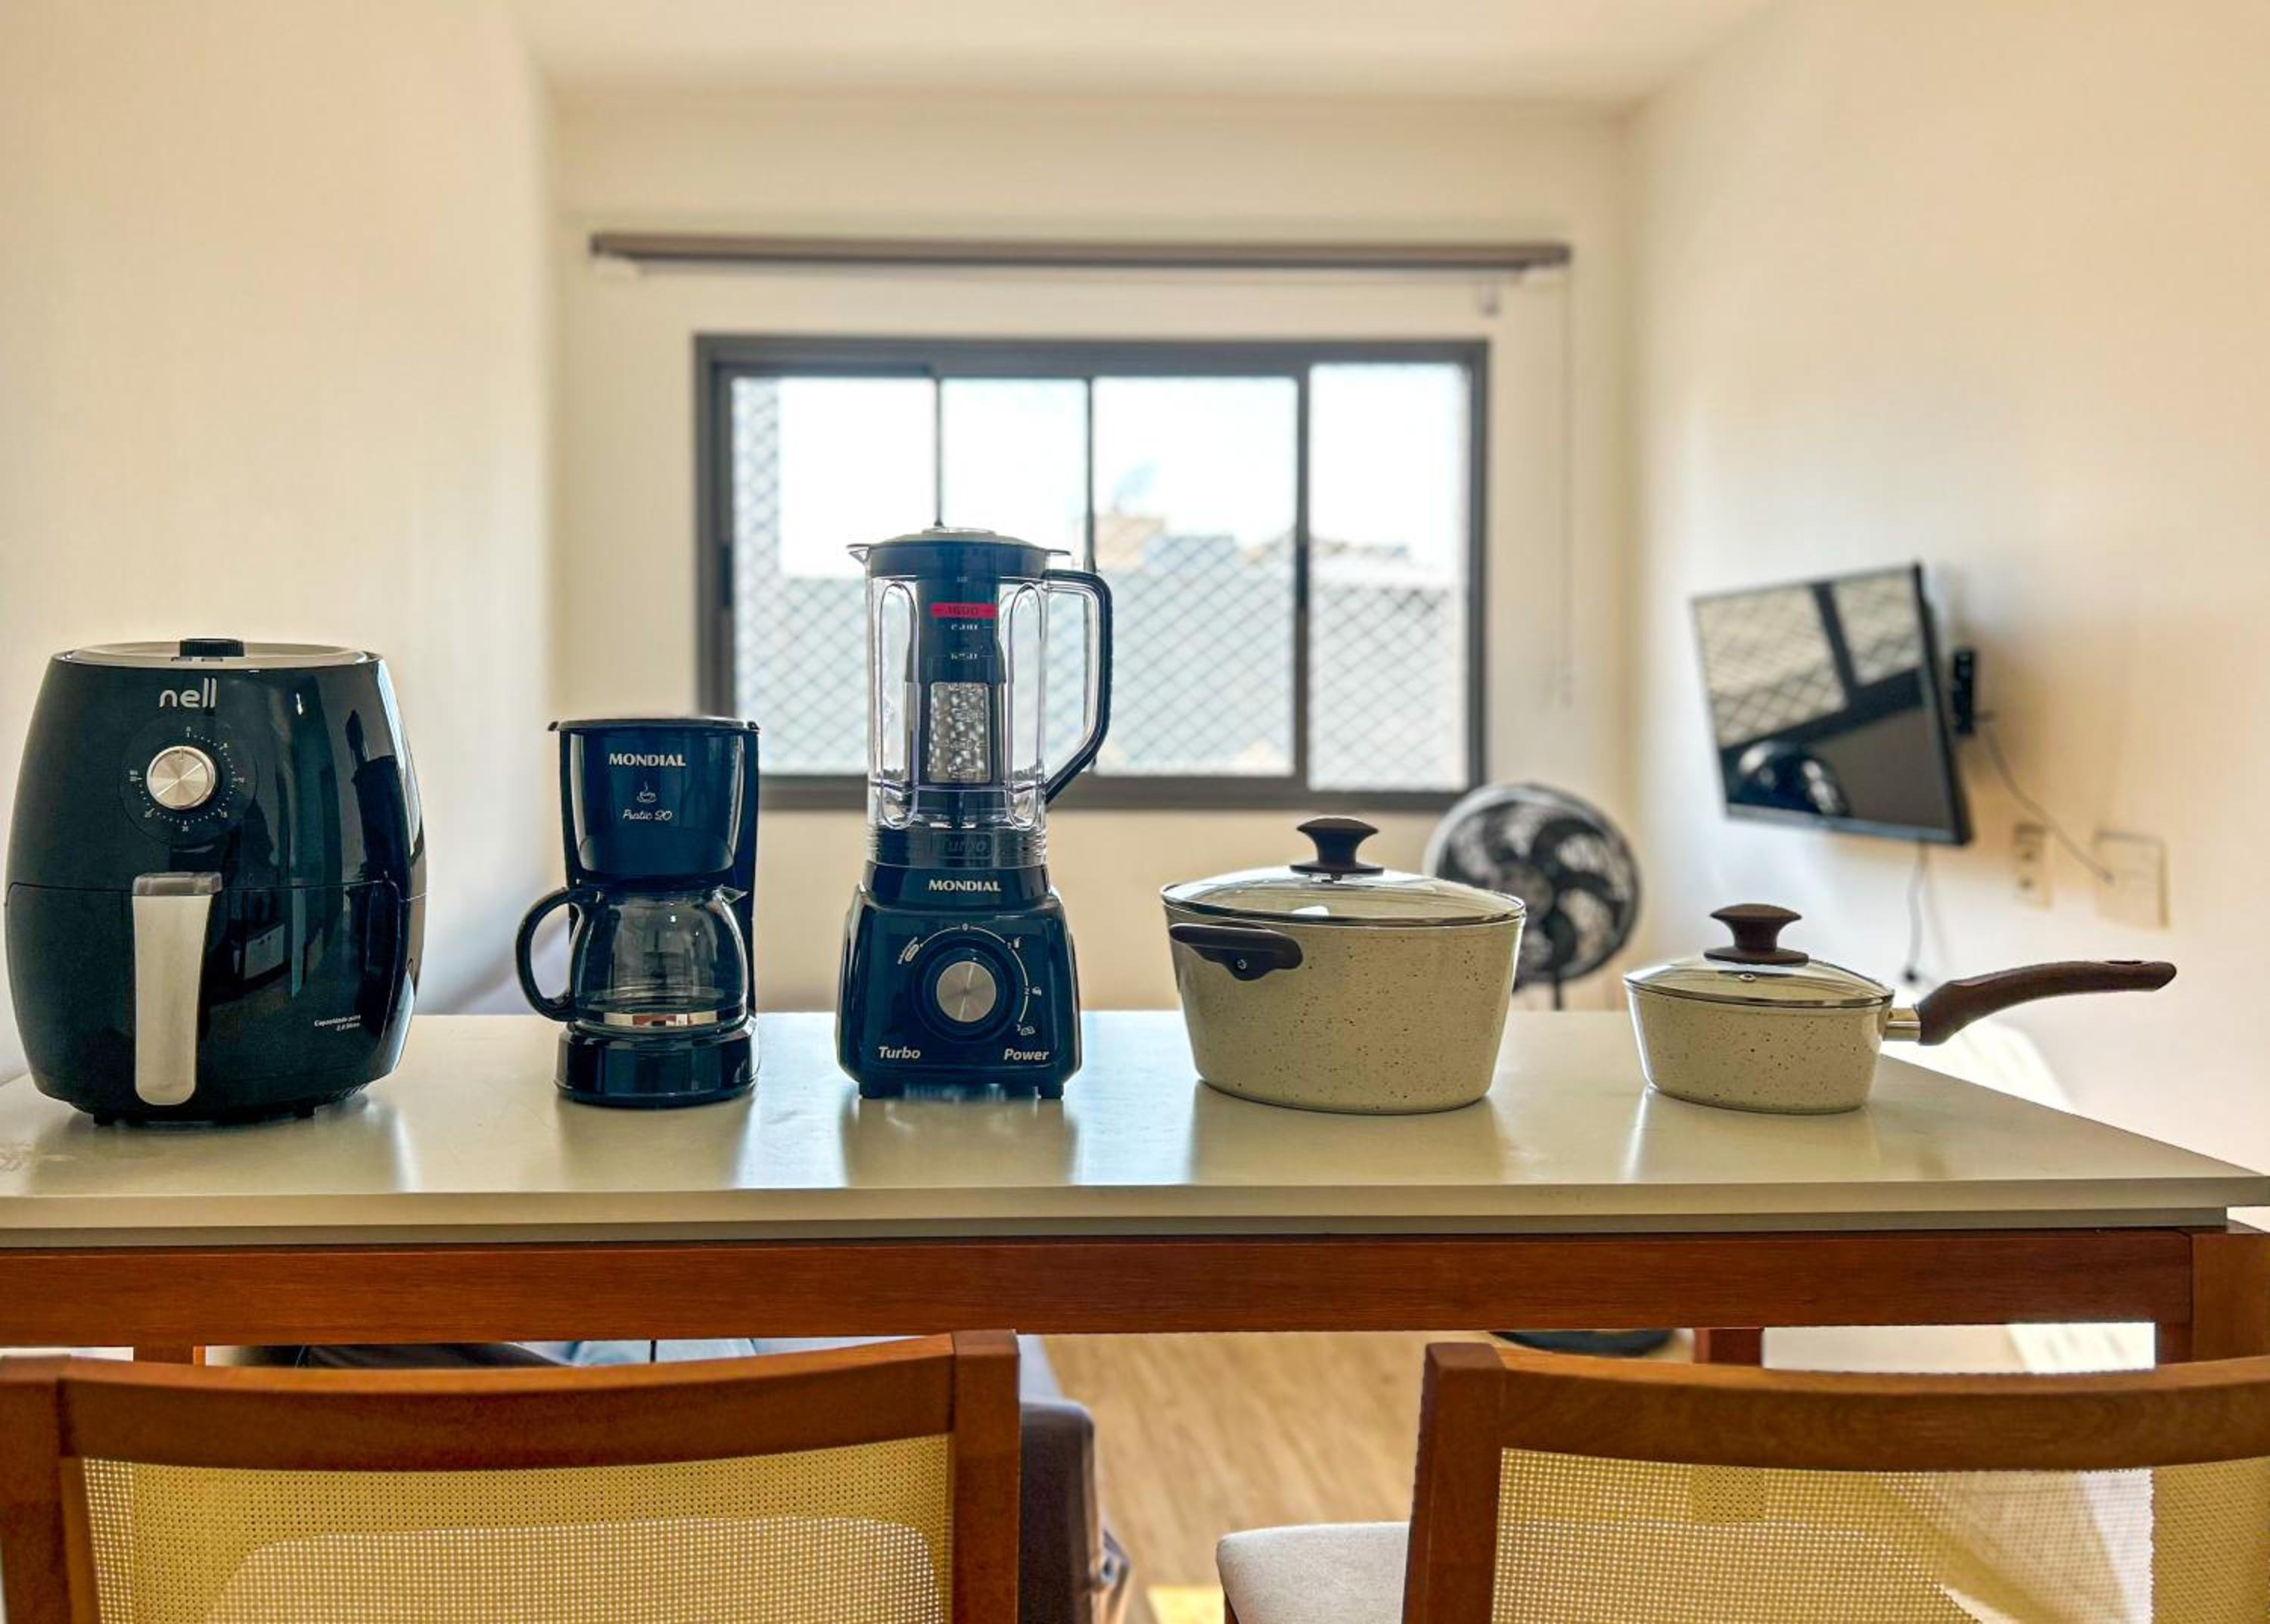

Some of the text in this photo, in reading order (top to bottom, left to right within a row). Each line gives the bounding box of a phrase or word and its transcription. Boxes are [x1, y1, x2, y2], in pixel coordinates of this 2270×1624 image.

[159, 677, 217, 708] nell
[608, 753, 686, 767] MONDIAL
[928, 879, 1002, 892] MONDIAL
[878, 1046, 1049, 1060] Turbo Power
